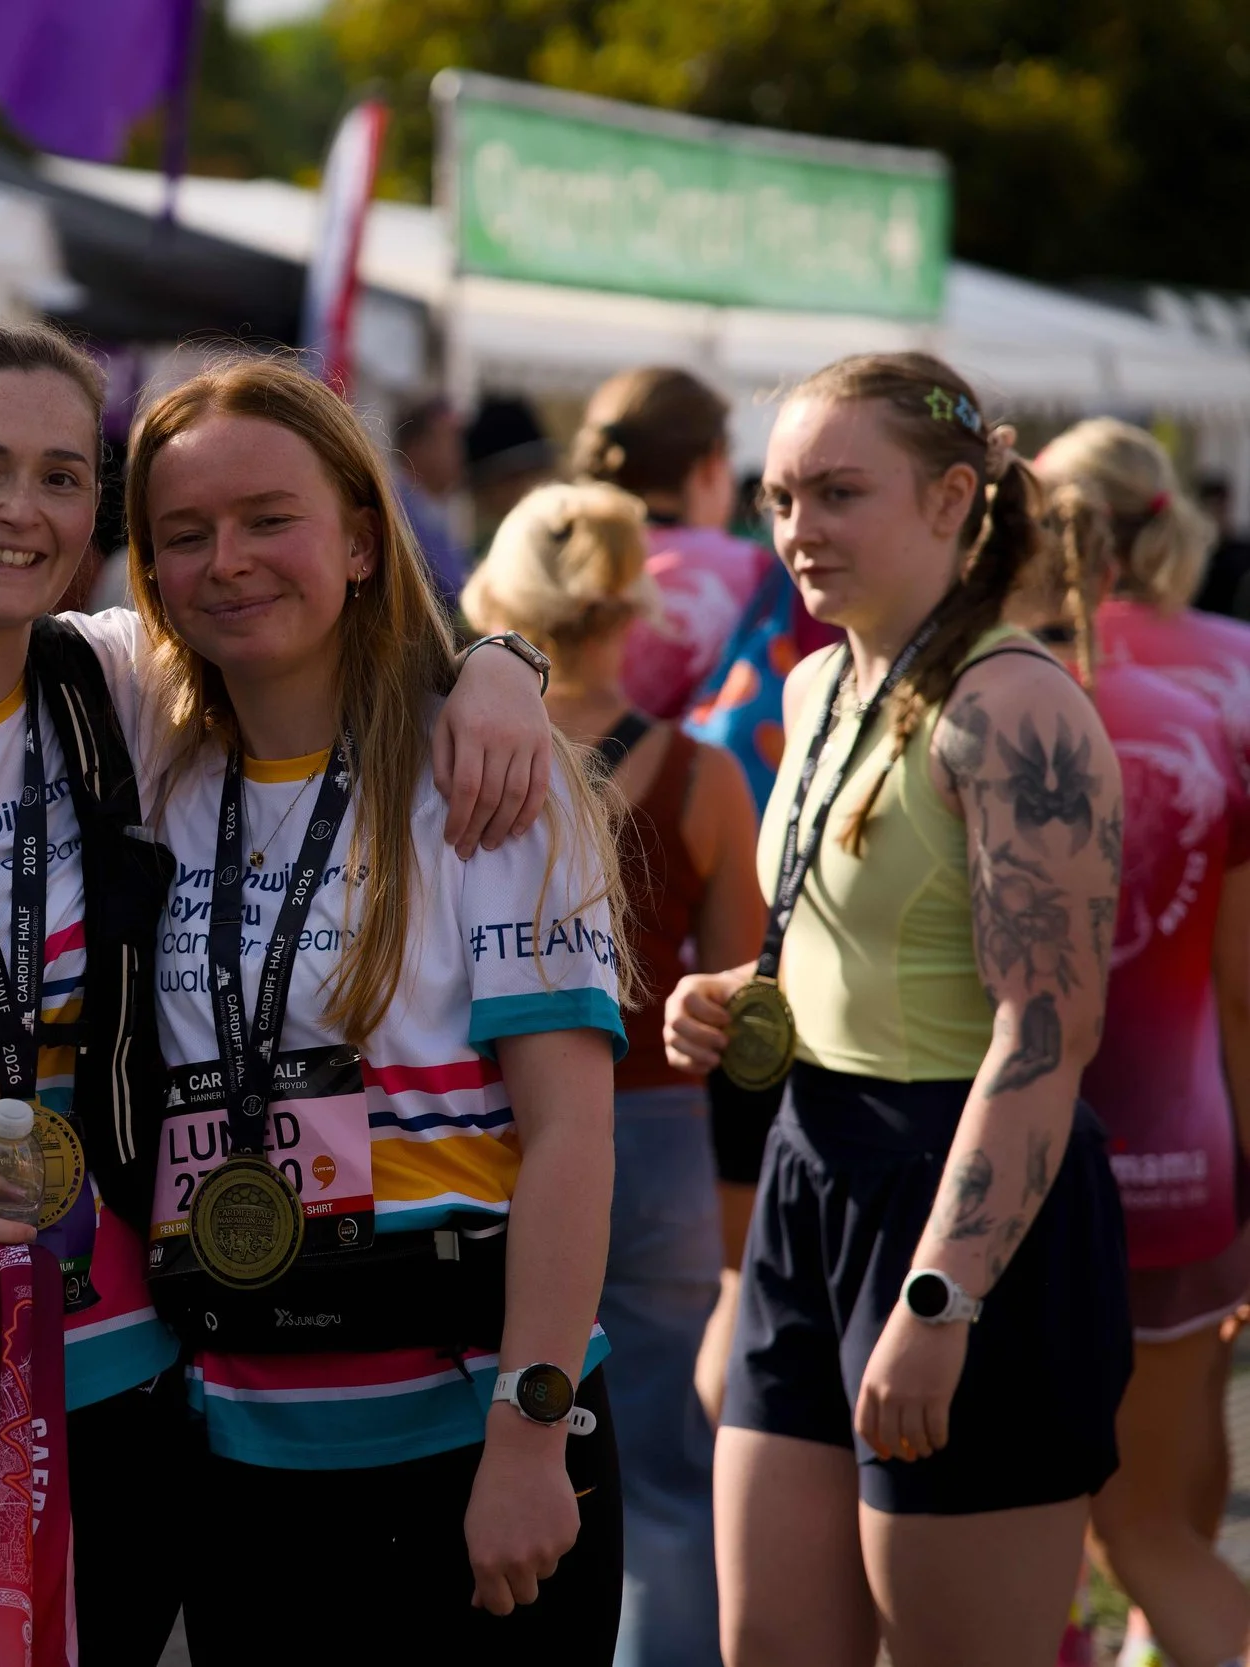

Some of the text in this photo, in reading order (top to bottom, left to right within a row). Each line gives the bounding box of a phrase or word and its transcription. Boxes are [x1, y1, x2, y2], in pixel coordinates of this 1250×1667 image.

[225, 803, 236, 840] 2026
[23, 836, 36, 876] 2026
[292, 869, 314, 906] 2026
[17, 905, 31, 1003] CARDIFF HALF
[259, 934, 286, 1031] CARDIFF HALF
[227, 993, 243, 1052] CARDIFF
[2, 1044, 22, 1085] 2026
[273, 1061, 307, 1079] ALF
[190, 1091, 222, 1103] HANNER
[314, 1165, 334, 1173] Cymraeg
[160, 1224, 174, 1234] PEN
[216, 1208, 275, 1219] CARDIFF HALF
[217, 1216, 274, 1225] MARATHON 2026
